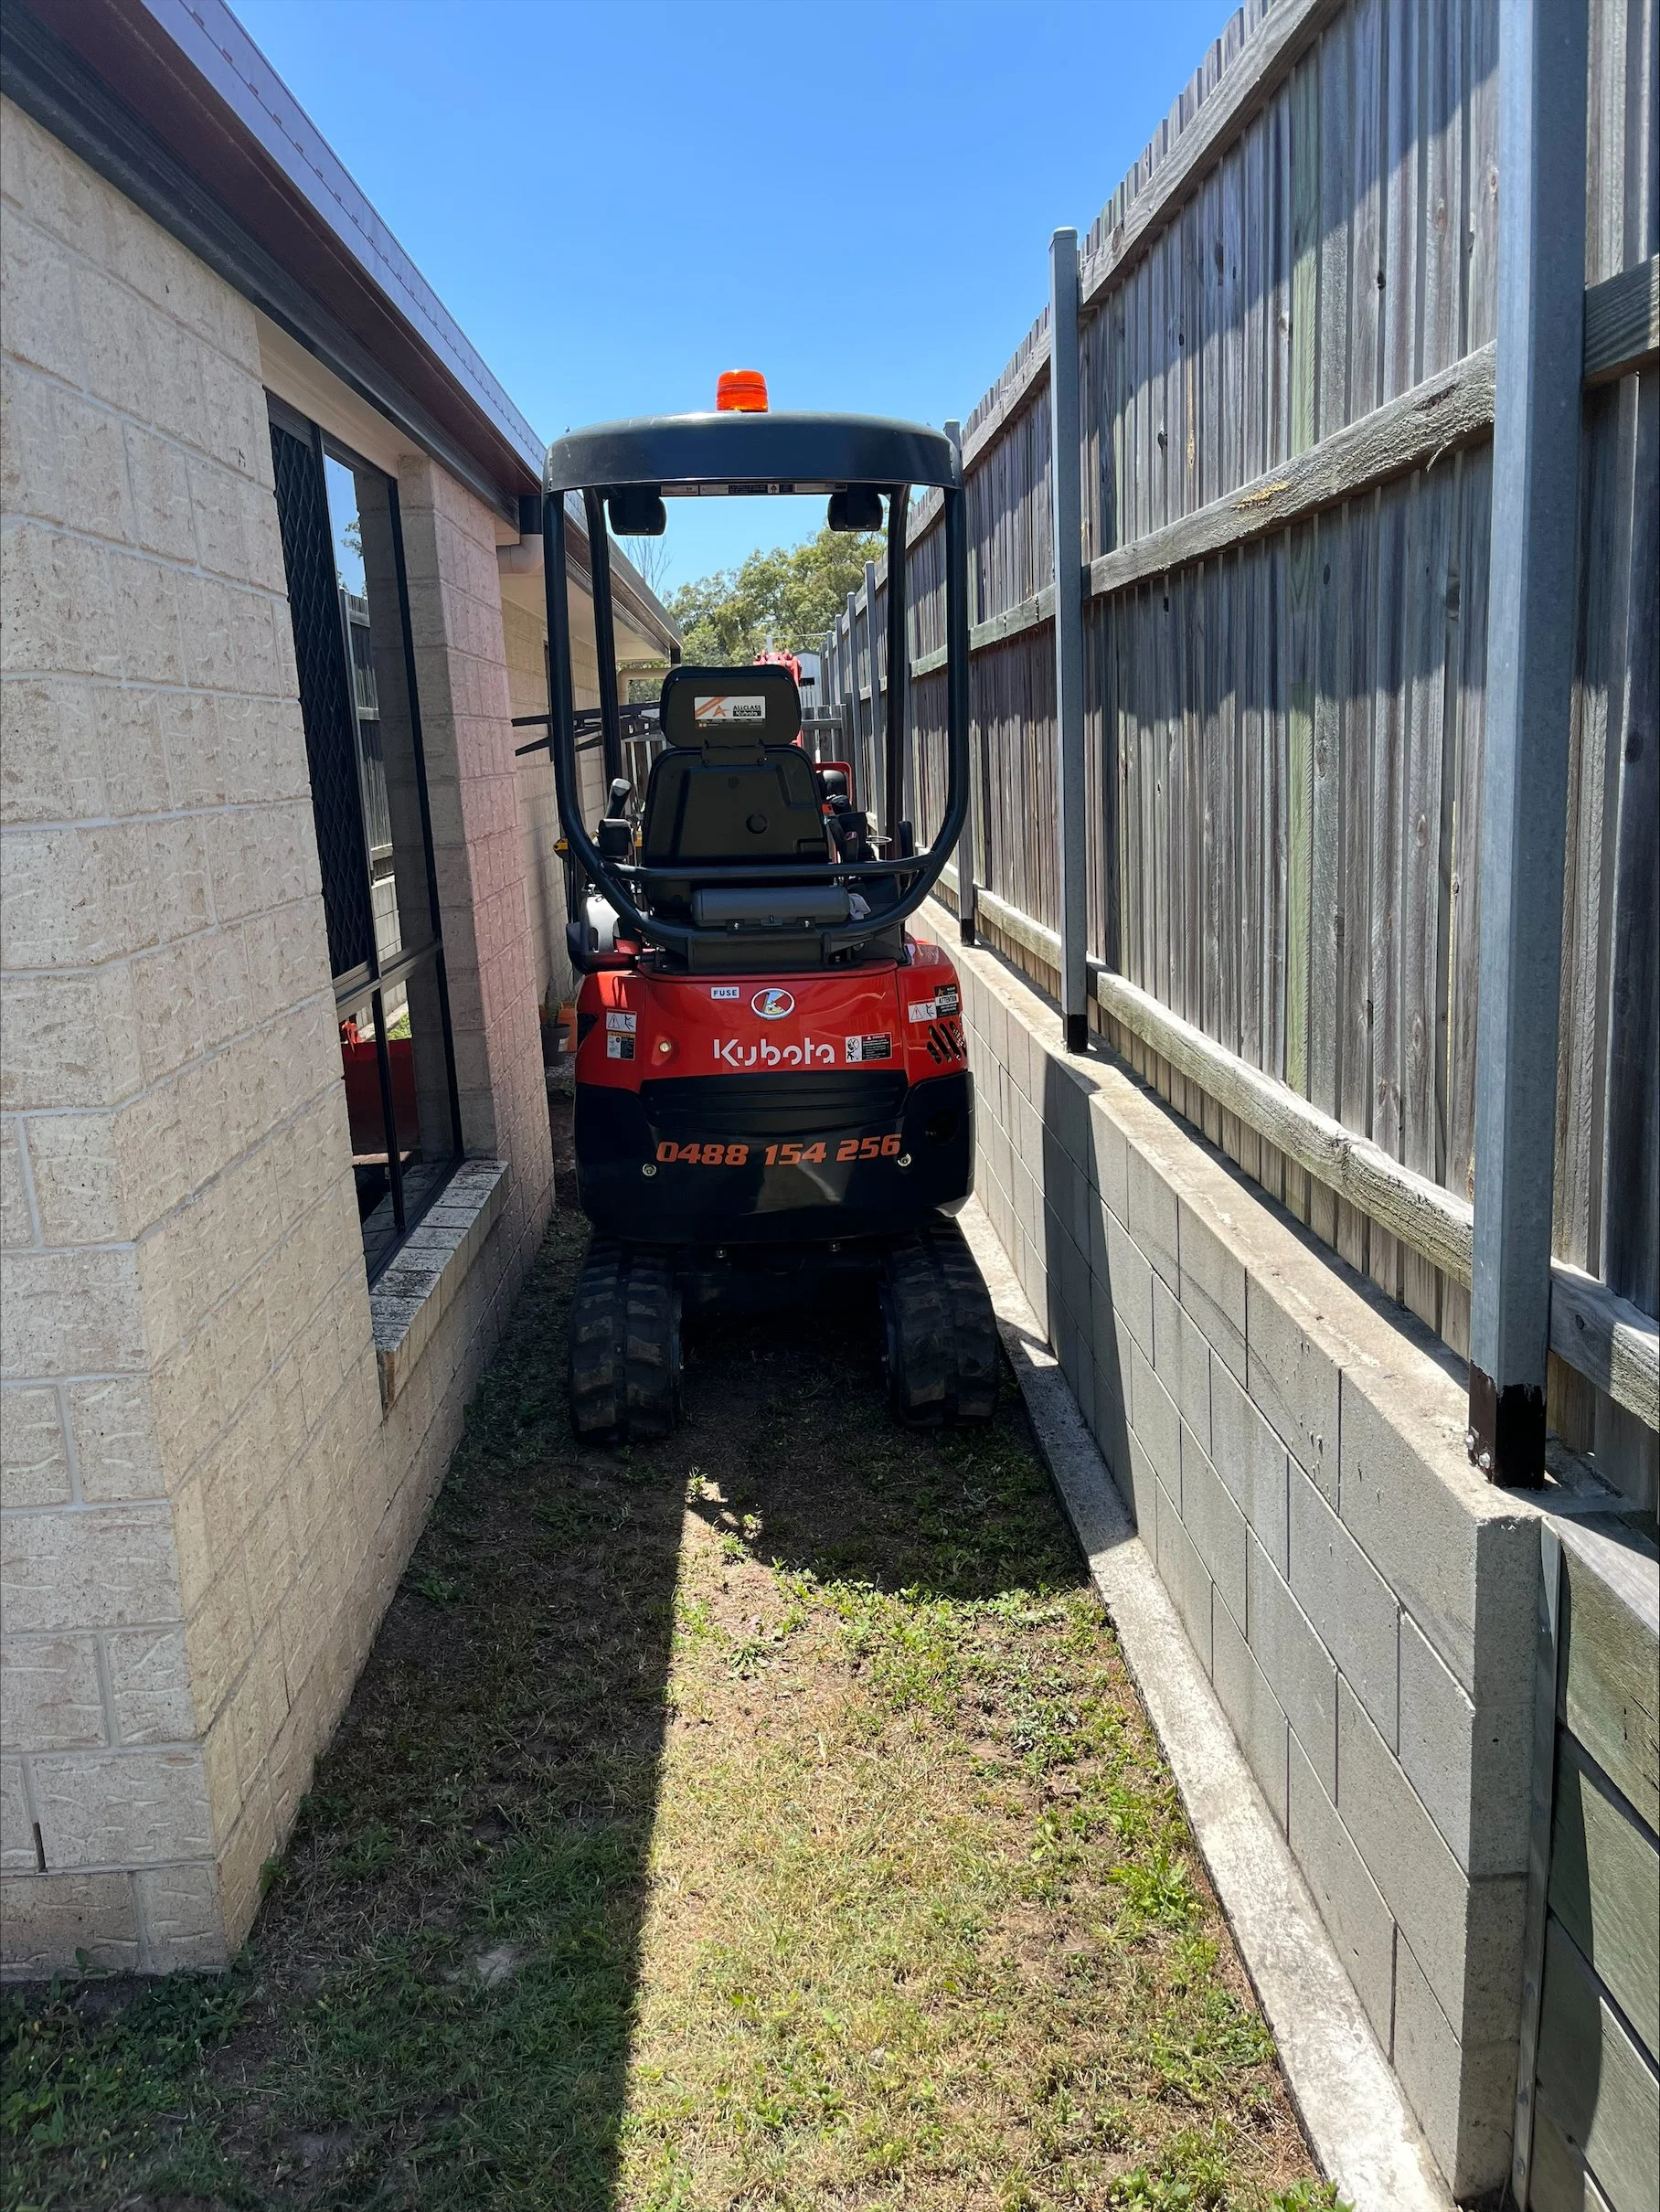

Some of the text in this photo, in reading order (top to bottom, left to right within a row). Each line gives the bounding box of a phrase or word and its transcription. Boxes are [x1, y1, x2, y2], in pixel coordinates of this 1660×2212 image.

[713, 1037, 835, 1067] Kubota
[656, 1133, 901, 1165] 0488 154 256
